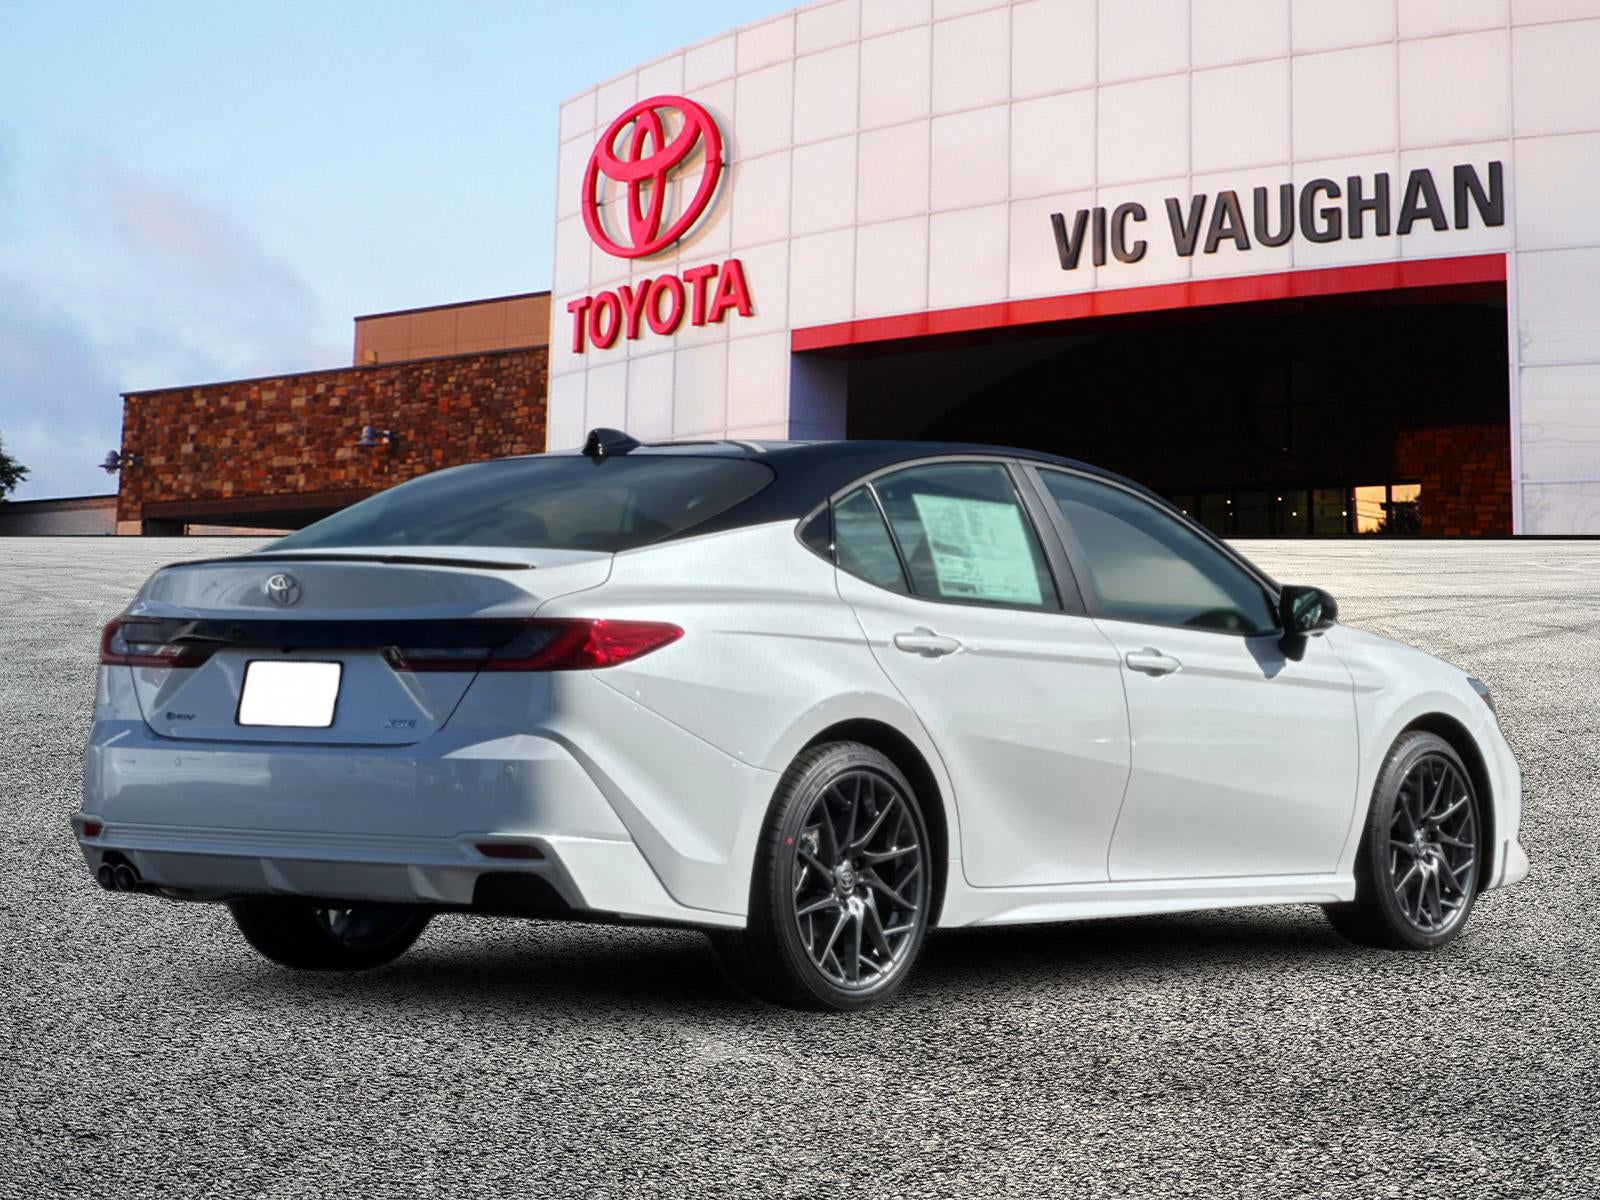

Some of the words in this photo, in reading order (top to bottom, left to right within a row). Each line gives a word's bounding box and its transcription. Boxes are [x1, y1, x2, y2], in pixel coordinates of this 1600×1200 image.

[1050, 201, 1148, 271] VIC
[1164, 160, 1505, 258] VAUGHAN
[567, 258, 754, 354] TOYOTA
